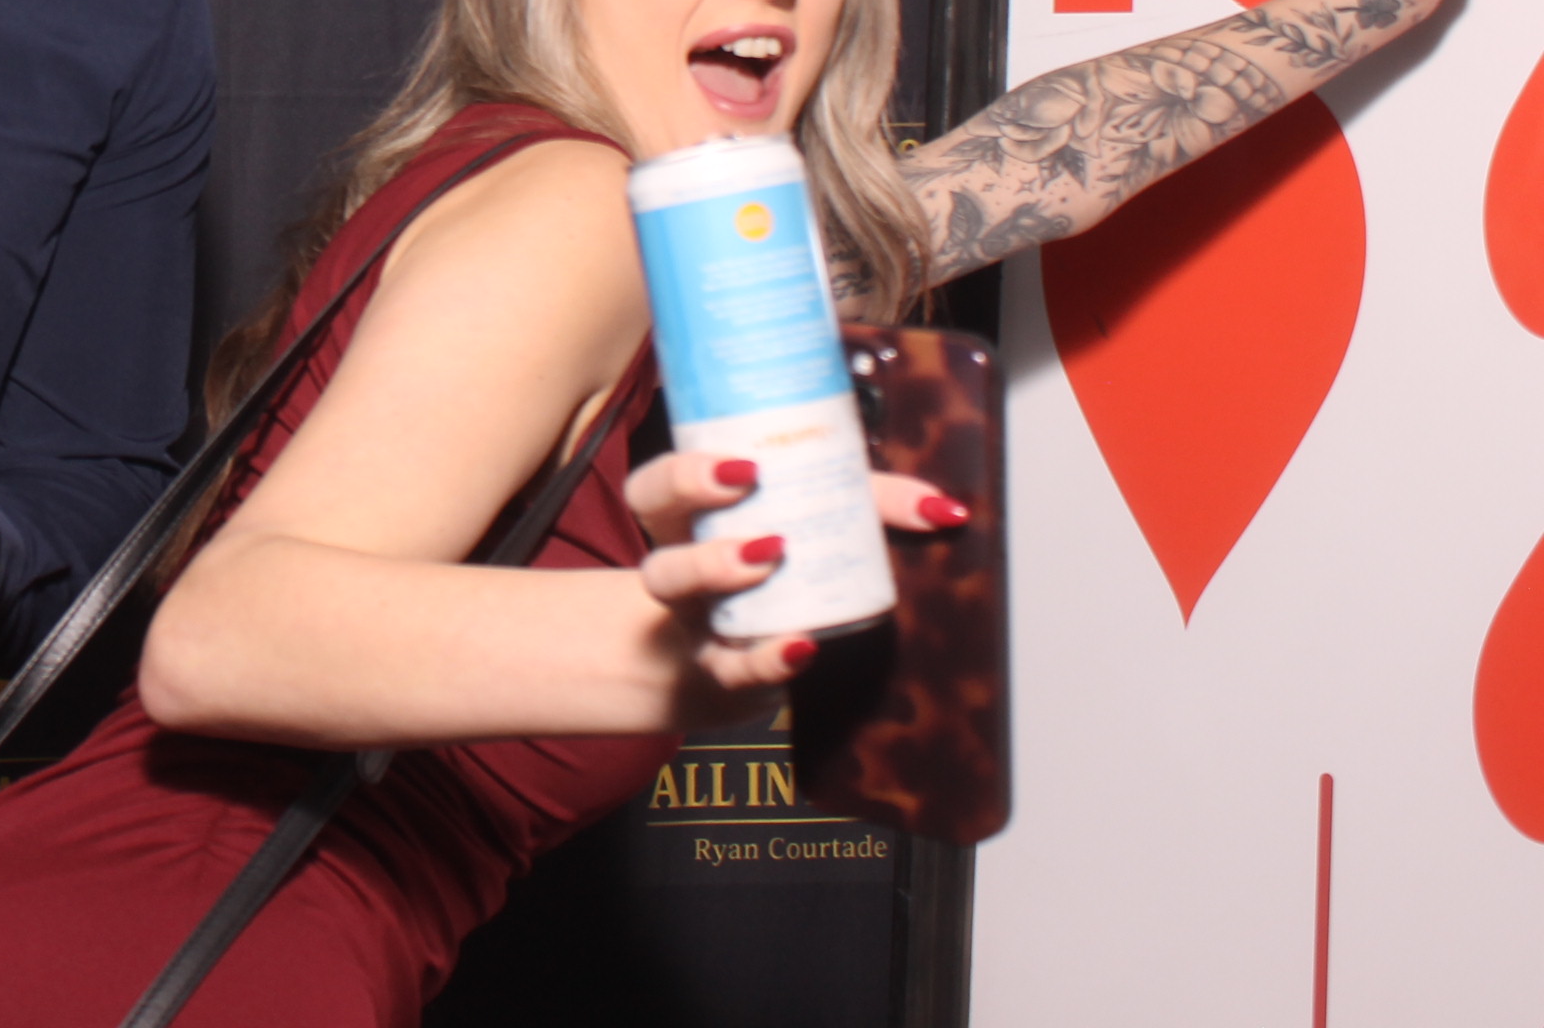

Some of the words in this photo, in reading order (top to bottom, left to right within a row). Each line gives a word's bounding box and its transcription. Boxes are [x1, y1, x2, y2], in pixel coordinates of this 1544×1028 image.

[648, 762, 736, 808] ALL
[745, 761, 795, 807] IN
[694, 838, 759, 867] Ryan
[768, 835, 889, 860] Courtade
